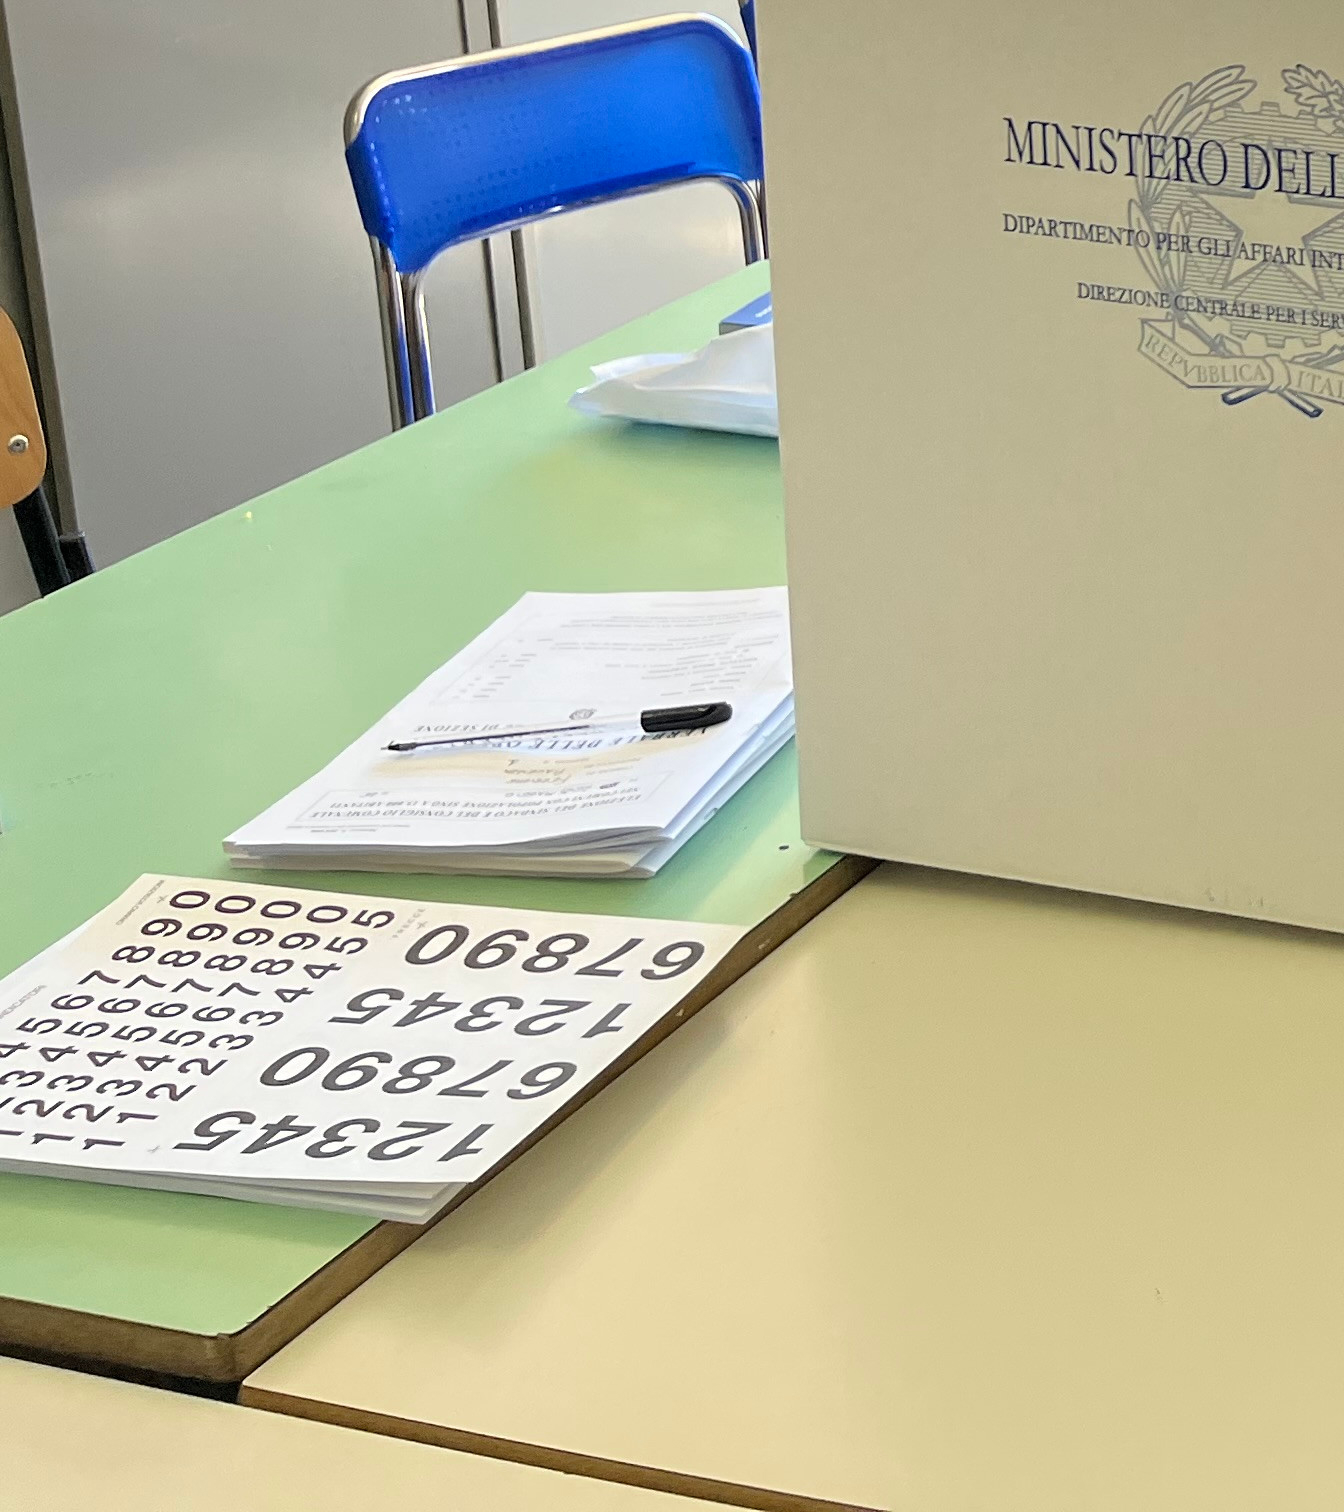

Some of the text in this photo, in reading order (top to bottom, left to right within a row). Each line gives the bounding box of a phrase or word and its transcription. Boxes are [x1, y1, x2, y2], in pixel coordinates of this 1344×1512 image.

[1002, 117, 1230, 186] MINISTERO
[1002, 213, 1154, 250] DIPARTIMENTO
[1154, 231, 1195, 256] PER
[1196, 234, 1232, 258] GLI
[1236, 239, 1306, 268] AFFARI
[1076, 282, 1172, 309] DIREZIONE
[1174, 293, 1262, 322] CENTRALE
[1264, 303, 1298, 324] PER
[405, 924, 705, 980] 67890
[327, 988, 632, 1038] 12345
[260, 1047, 577, 1100] 67890
[172, 1111, 495, 1162] 12345
